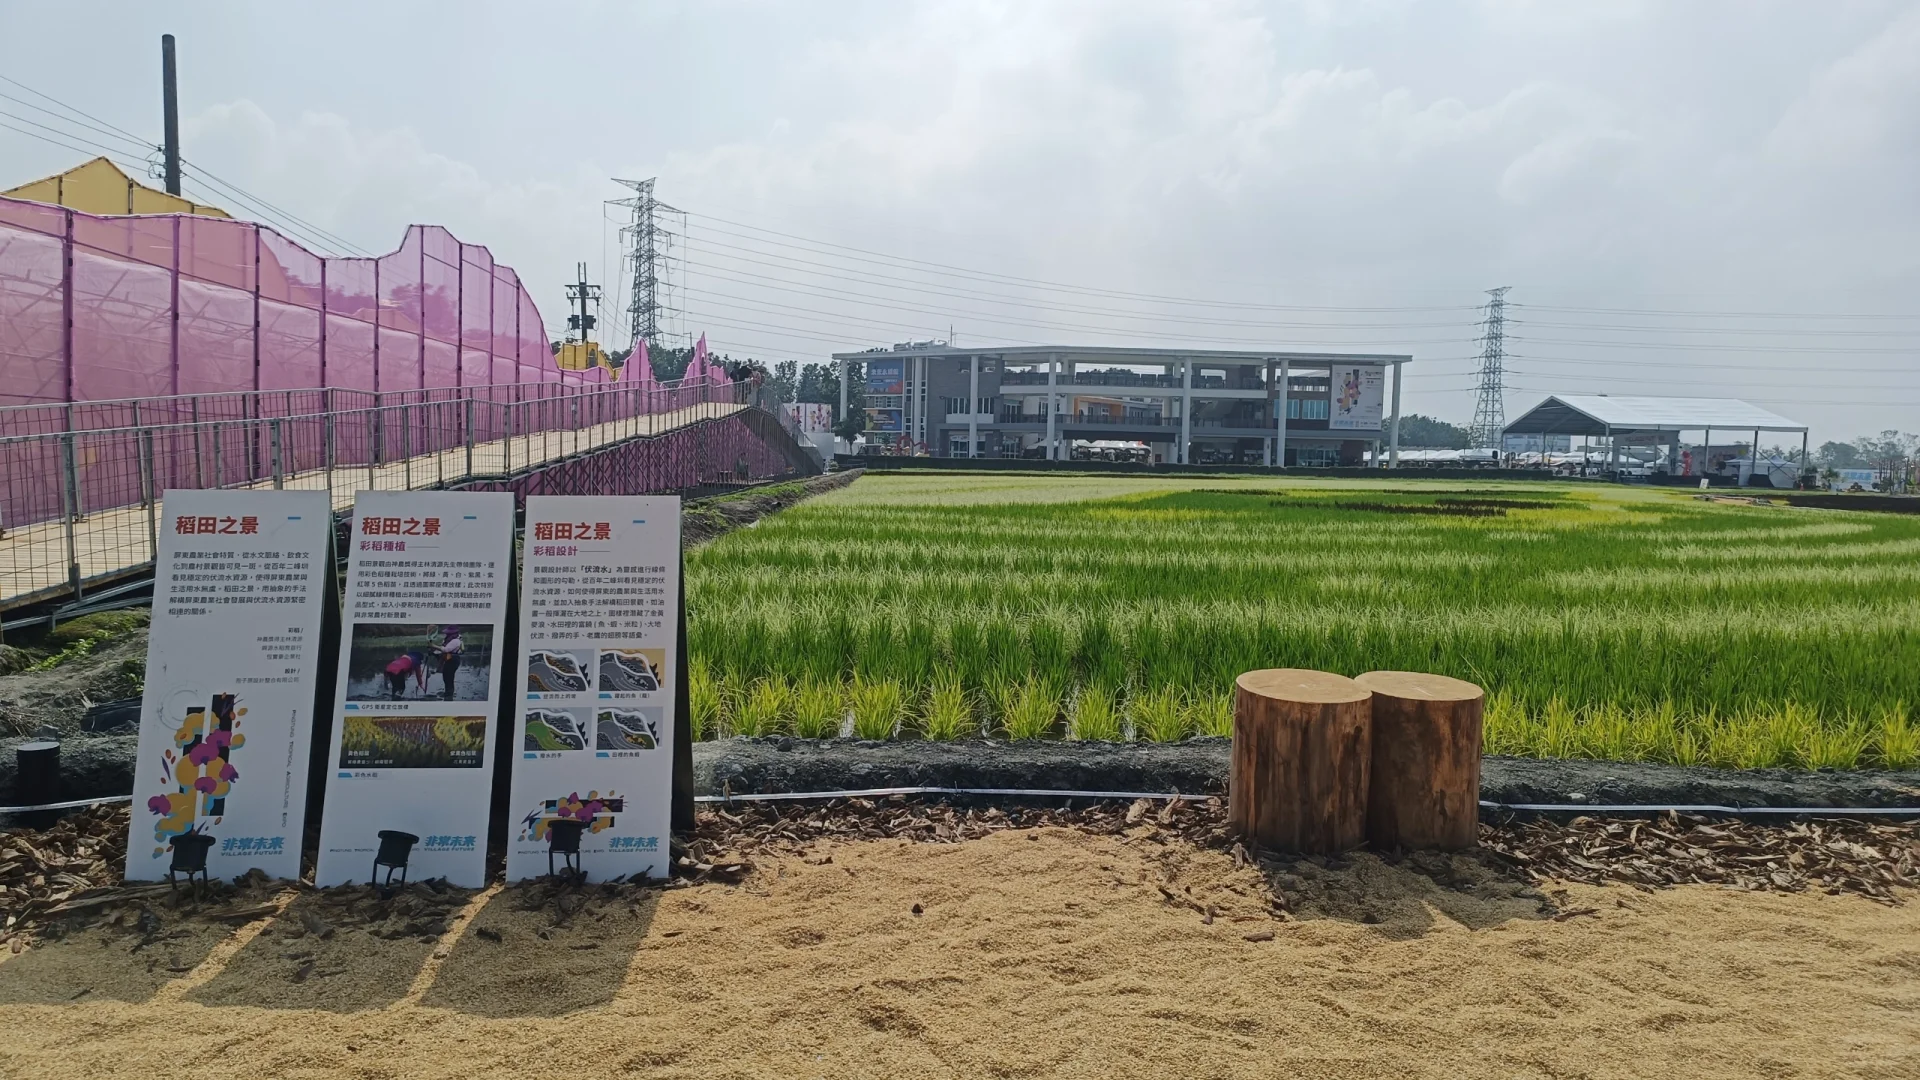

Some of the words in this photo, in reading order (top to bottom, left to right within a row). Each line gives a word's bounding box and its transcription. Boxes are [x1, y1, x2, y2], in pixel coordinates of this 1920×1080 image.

[175, 515, 259, 535] 稻田之景
[361, 517, 441, 536] 稻田之景
[534, 522, 611, 541] 稻田之景
[359, 541, 406, 552] 彩稻種植
[533, 546, 578, 557] 彩稻設計
[222, 836, 285, 851] 非常未來
[425, 835, 476, 847] 非常未來
[609, 836, 659, 848] 非常未來
